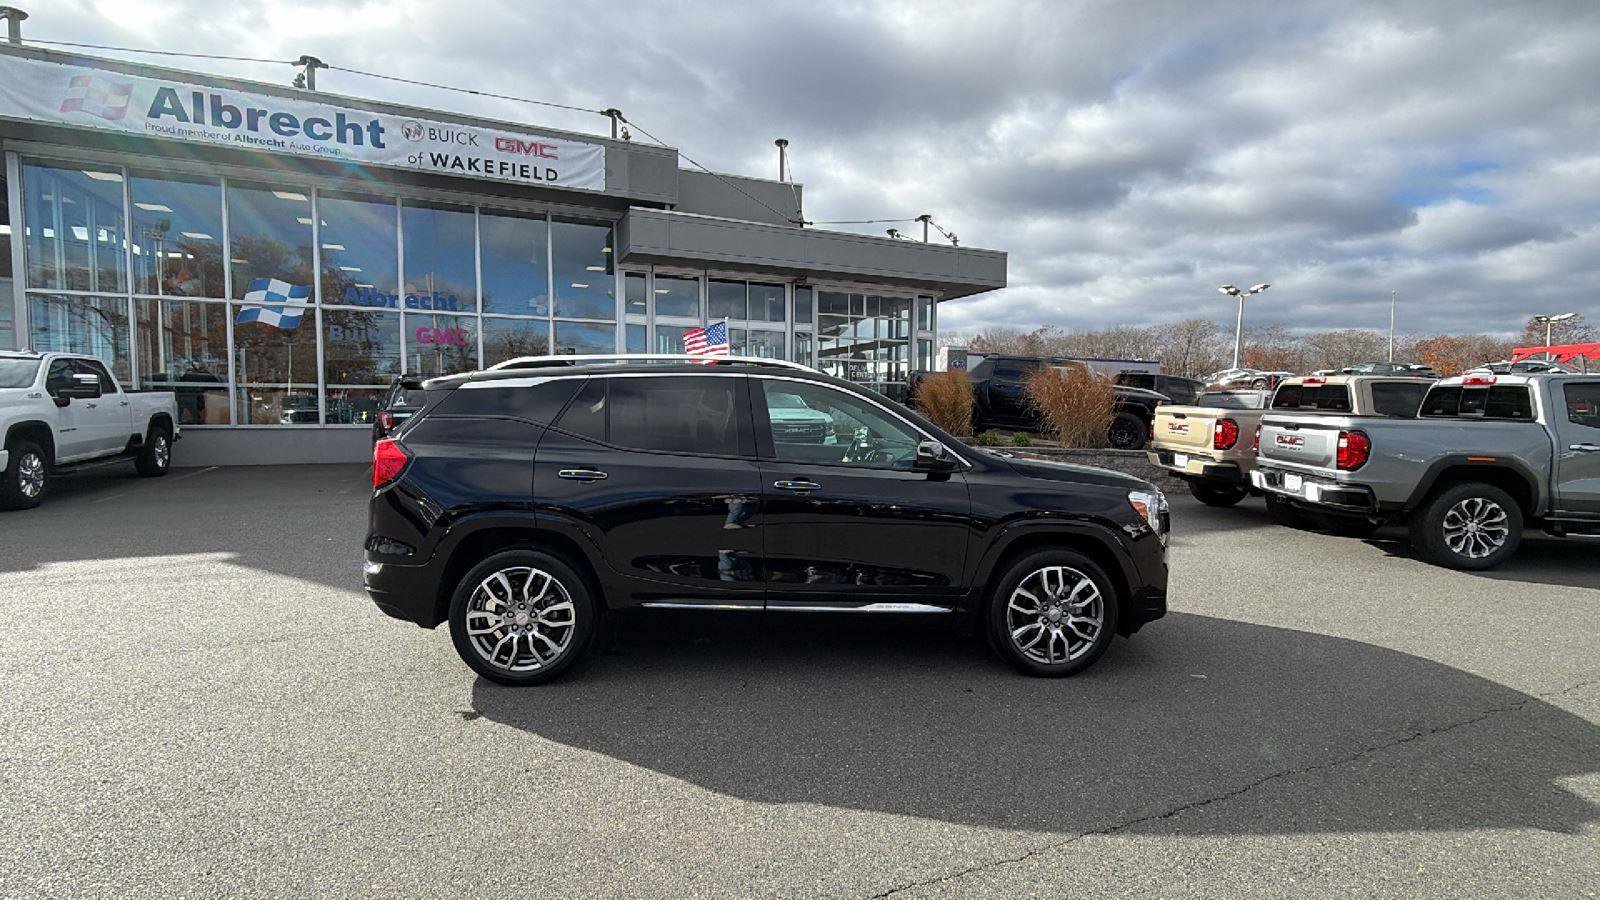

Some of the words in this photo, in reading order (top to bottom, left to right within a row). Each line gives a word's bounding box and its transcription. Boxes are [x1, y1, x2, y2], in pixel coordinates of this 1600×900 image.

[146, 86, 386, 149] Albrecht
[145, 122, 176, 135] Proud
[177, 127, 219, 141] member
[220, 132, 231, 142] of
[234, 134, 285, 148] Albrecht
[289, 141, 311, 152] Auto
[313, 144, 341, 156] Group
[428, 127, 479, 148] BUICK
[495, 136, 559, 160] GMC
[407, 152, 424, 166] of
[429, 152, 558, 182] WAKEFIELD
[342, 286, 458, 311] Albrecht
[415, 326, 469, 348] GMC
